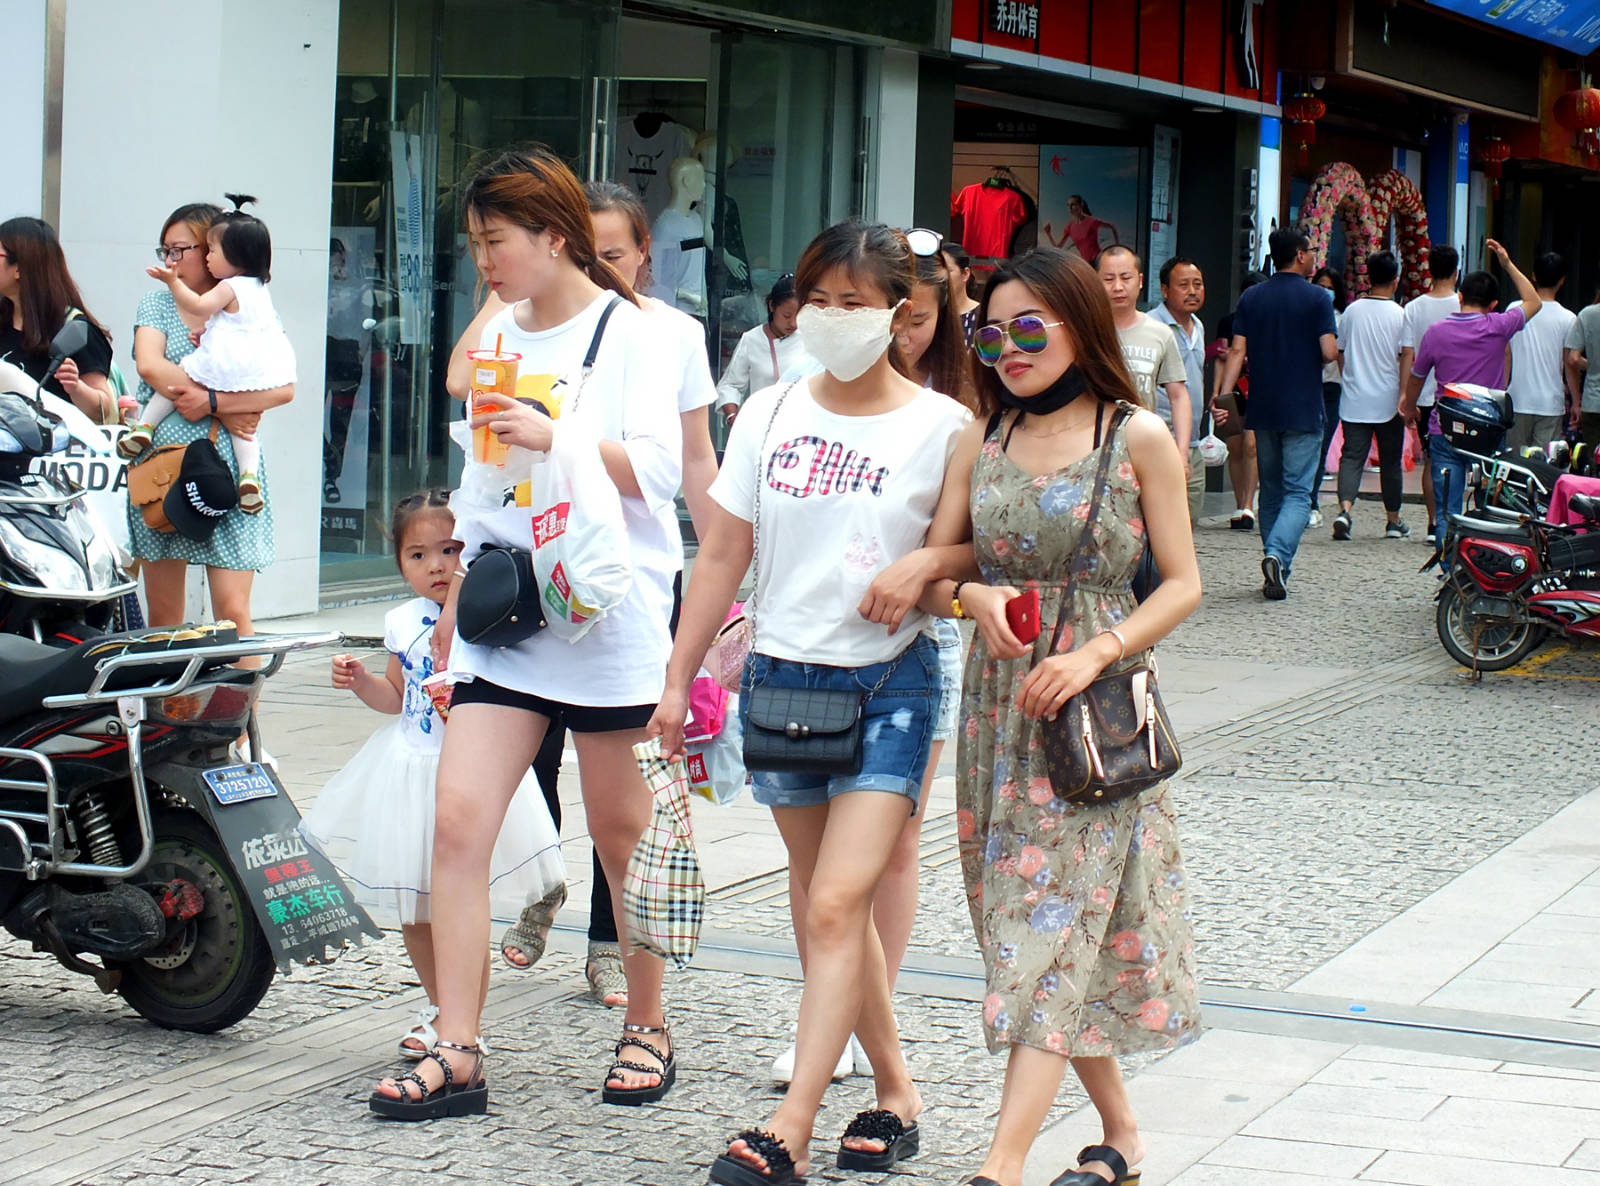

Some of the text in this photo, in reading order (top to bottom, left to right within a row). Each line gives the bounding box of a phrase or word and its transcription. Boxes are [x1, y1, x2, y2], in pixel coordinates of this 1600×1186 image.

[996, 0, 1039, 40] 乔丹体育
[216, 776, 269, 795] 3725720
[265, 884, 345, 925] 豪杰车行
